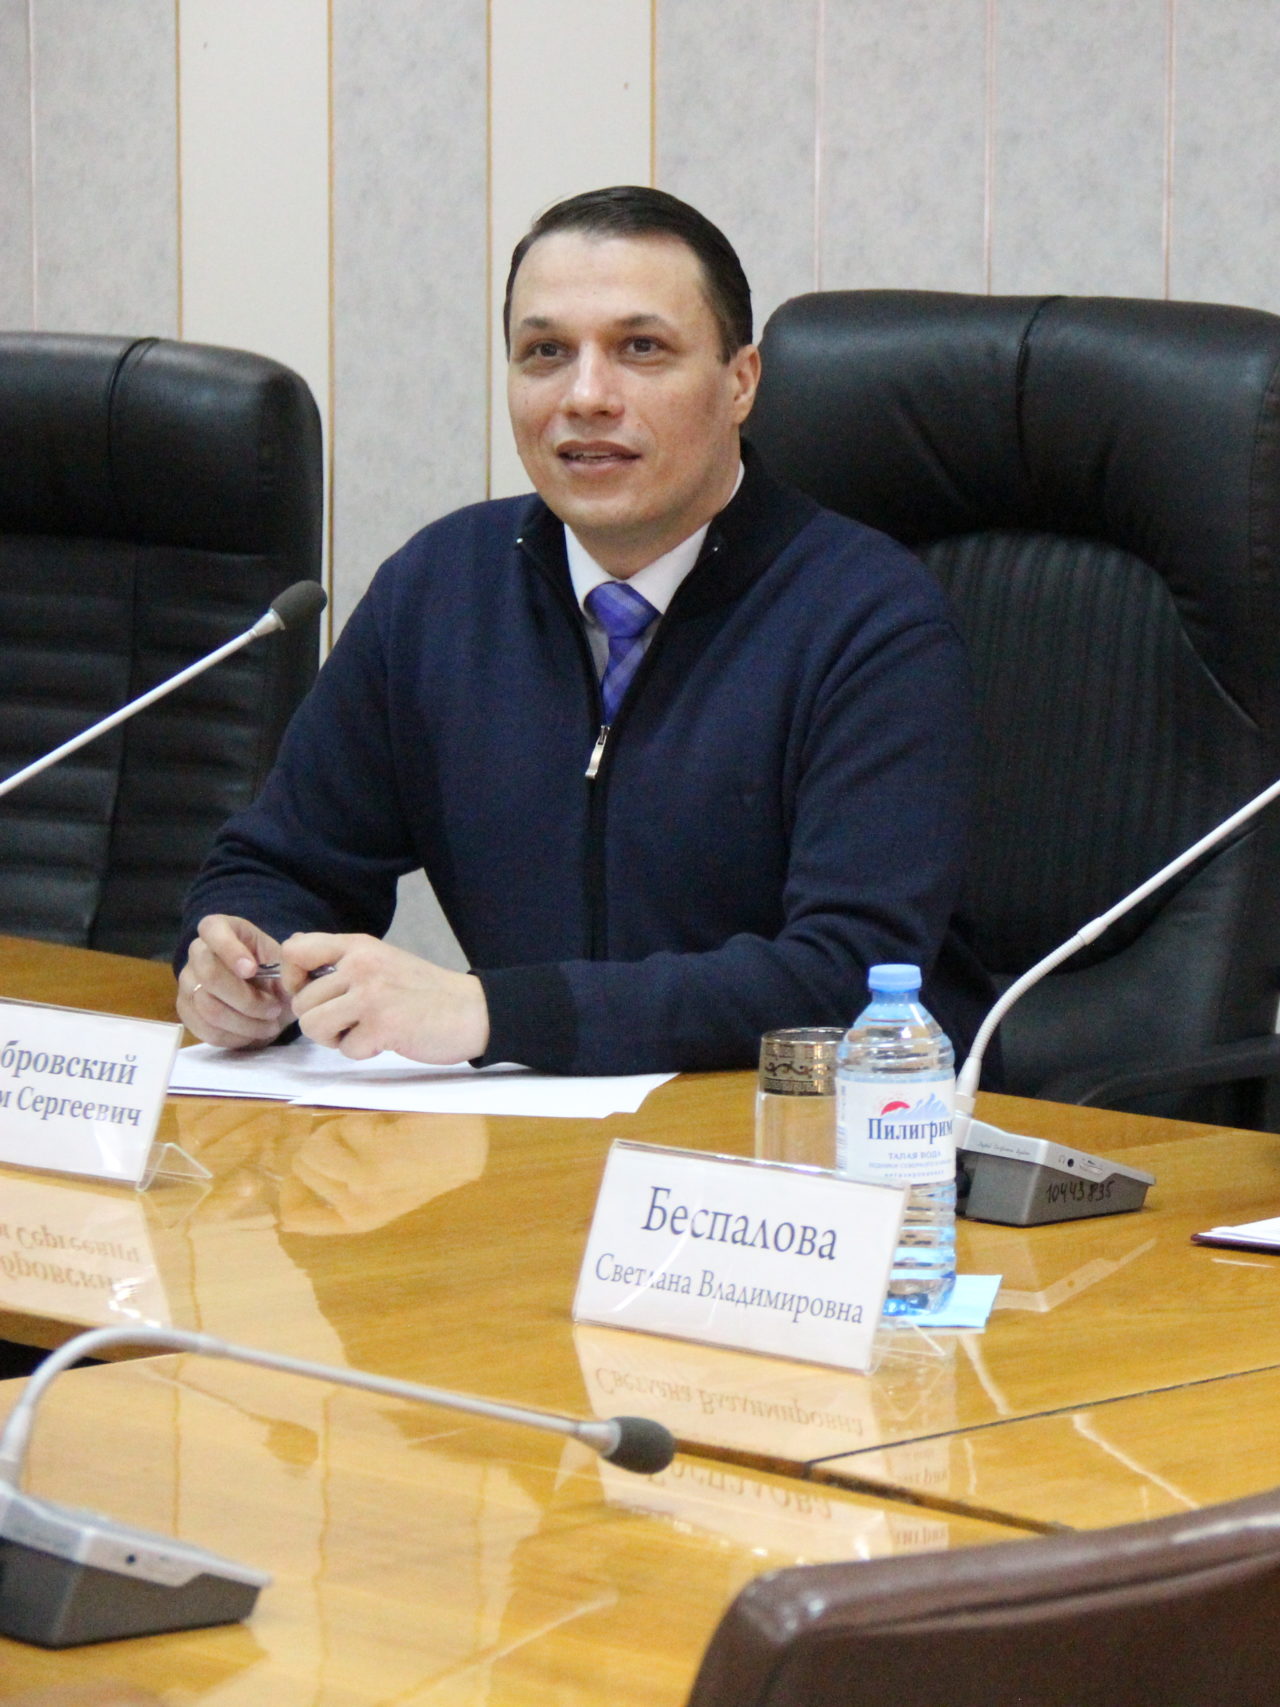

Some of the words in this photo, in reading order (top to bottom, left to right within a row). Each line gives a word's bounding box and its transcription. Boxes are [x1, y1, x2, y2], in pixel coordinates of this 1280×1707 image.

[17, 1086, 142, 1127] Сергеевич
[868, 1117, 952, 1145] Пилигрим
[641, 1185, 838, 1261] Беспалова
[595, 1252, 692, 1295] Светлана
[697, 1269, 864, 1324] Владимировна
